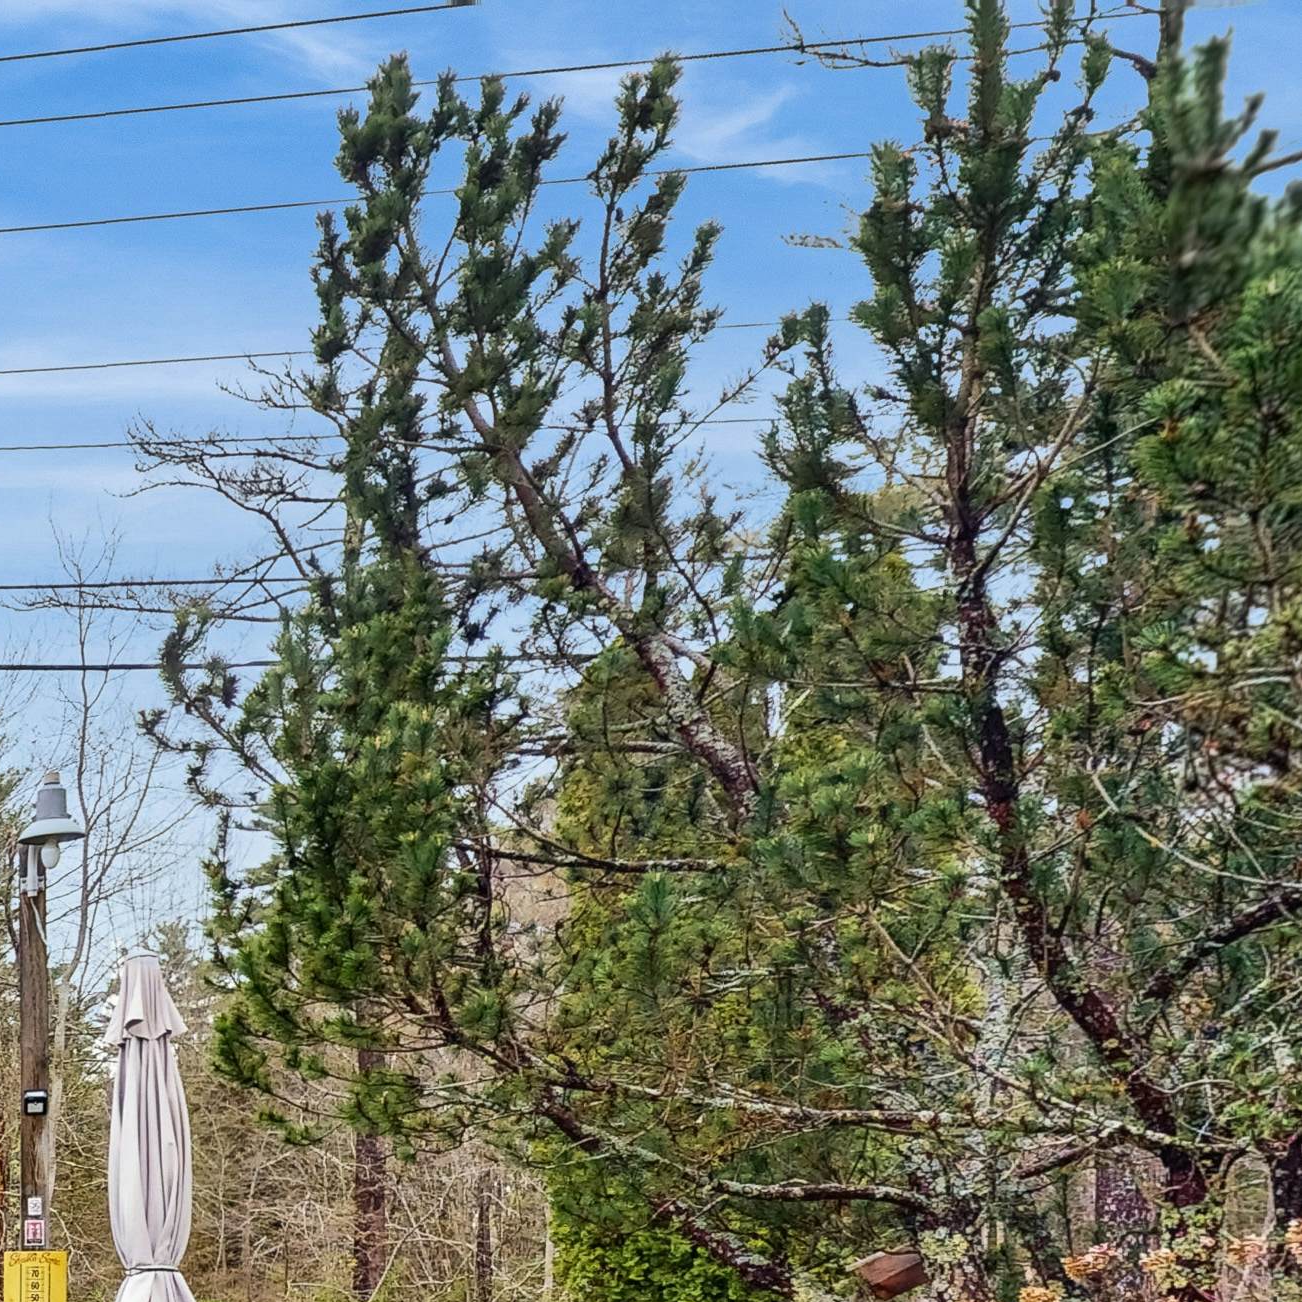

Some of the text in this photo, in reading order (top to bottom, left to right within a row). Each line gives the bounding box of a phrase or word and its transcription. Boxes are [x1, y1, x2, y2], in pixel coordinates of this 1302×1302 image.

[31, 1269, 40, 1278] 70
[30, 1281, 40, 1290] 60
[30, 1293, 40, 1302] 50
